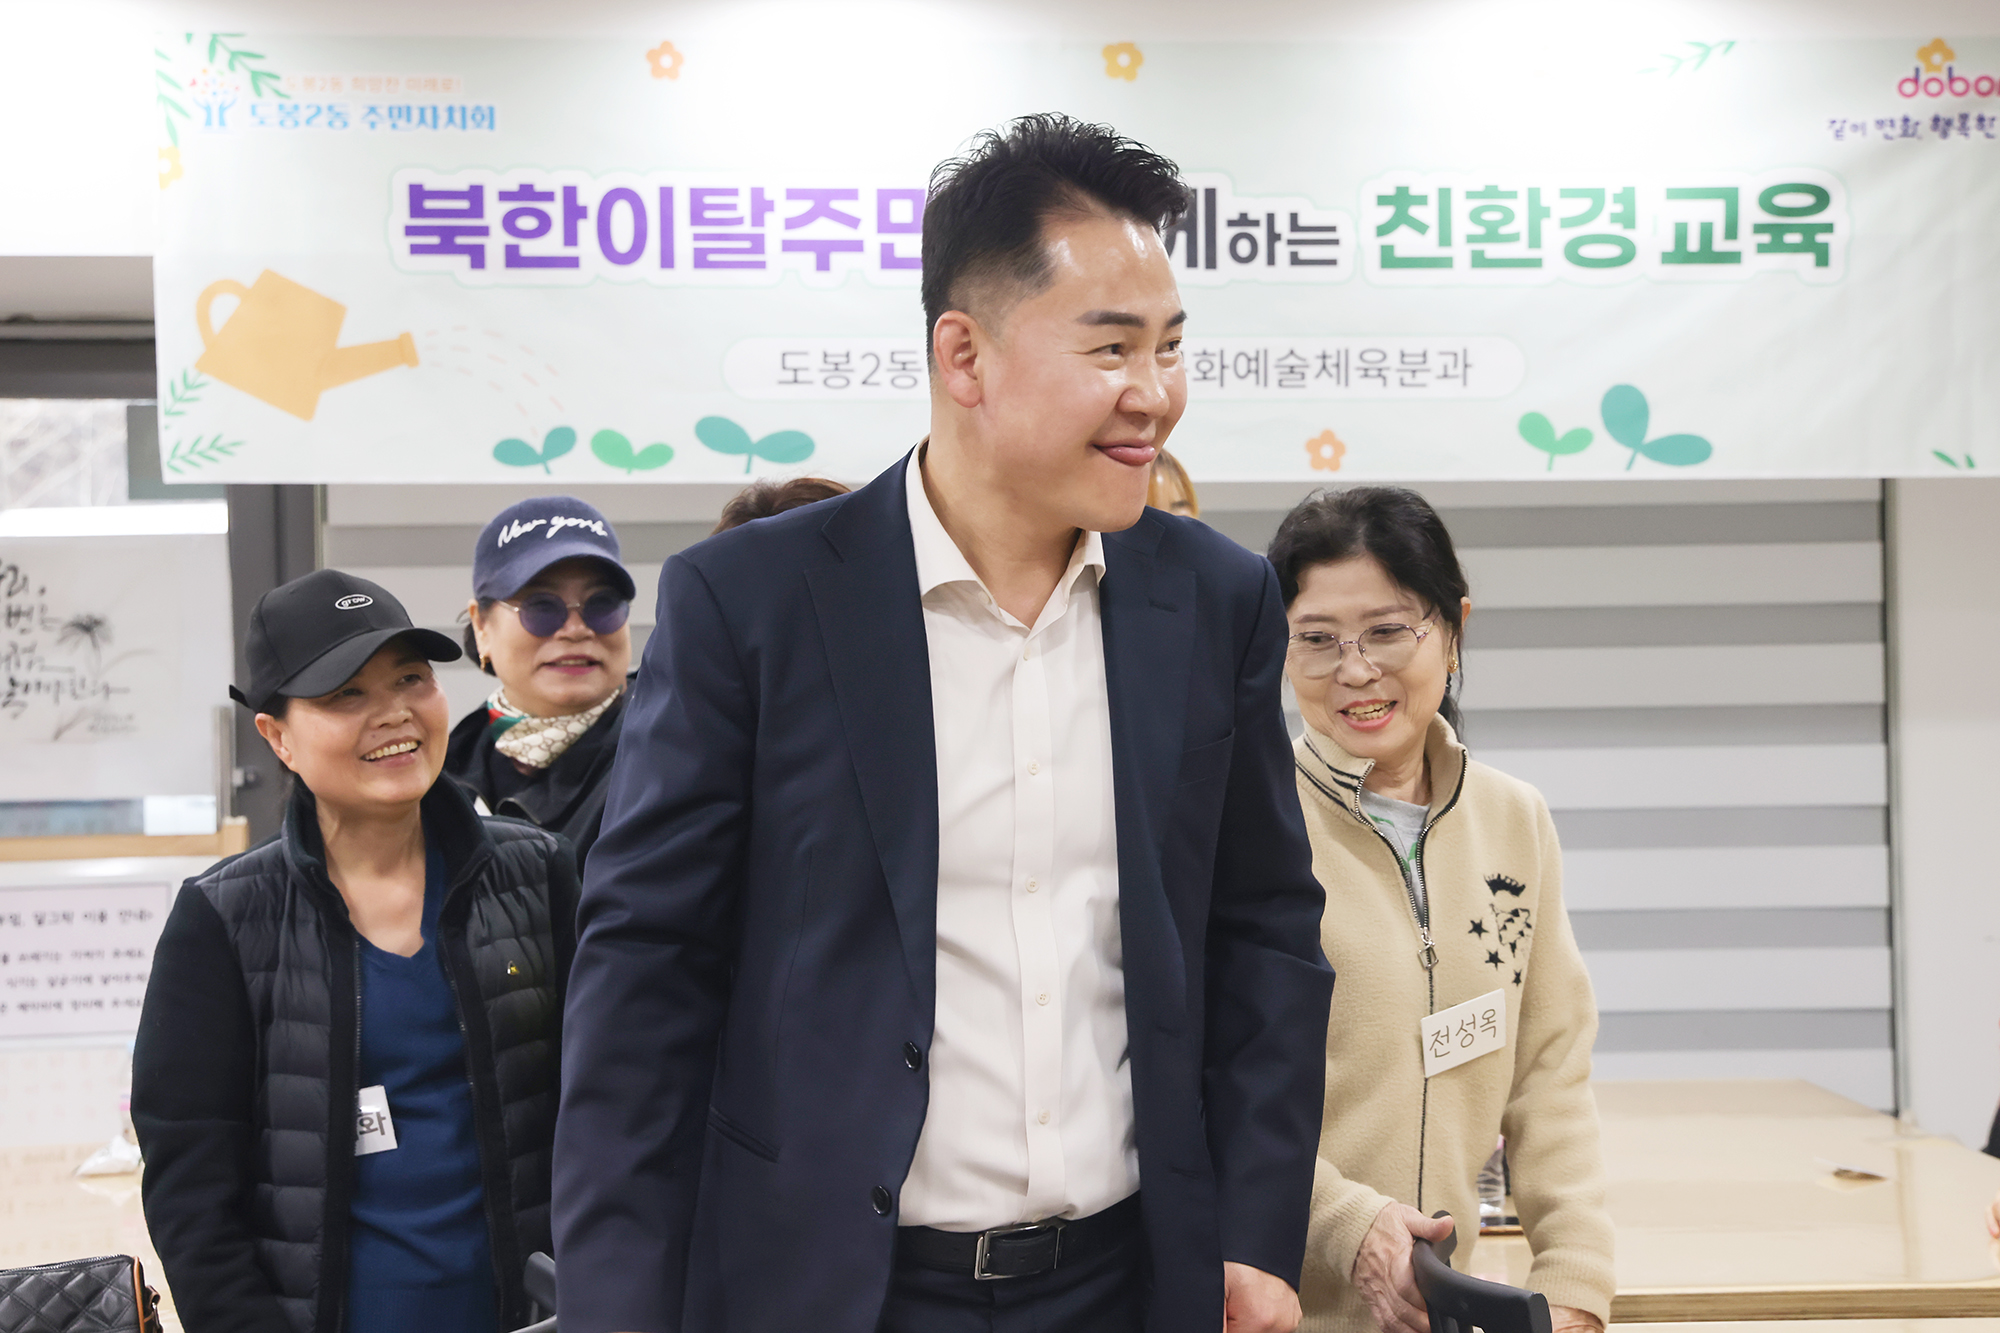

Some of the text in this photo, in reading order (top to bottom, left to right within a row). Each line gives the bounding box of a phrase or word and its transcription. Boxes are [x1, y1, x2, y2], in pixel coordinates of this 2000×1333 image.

[1898, 66, 2000, 98] dobo
[250, 103, 496, 131] 도봉2동 주민자치회
[1376, 185, 1637, 269] 친환경
[1661, 182, 1835, 268] 교육
[777, 348, 1472, 389] 도봉2동 화예술체육분과
[498, 518, 547, 548] New
[1429, 1008, 1498, 1059] 전성옥
